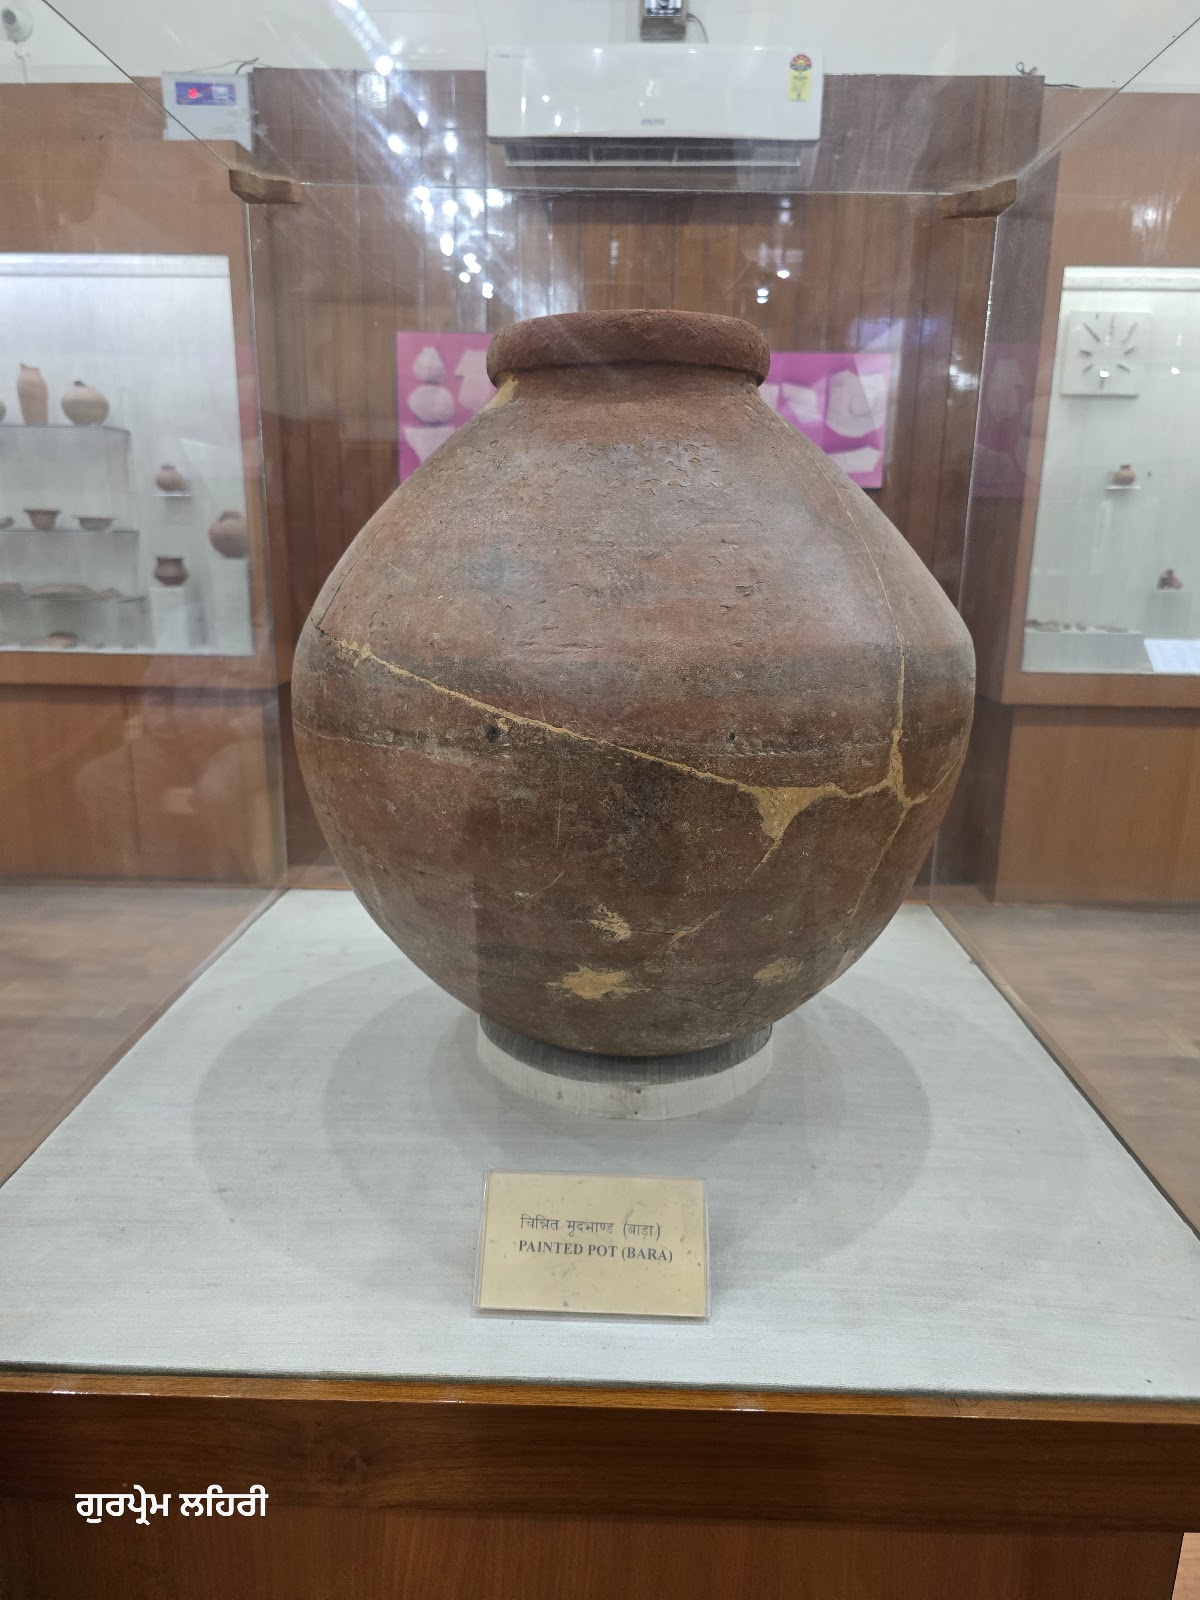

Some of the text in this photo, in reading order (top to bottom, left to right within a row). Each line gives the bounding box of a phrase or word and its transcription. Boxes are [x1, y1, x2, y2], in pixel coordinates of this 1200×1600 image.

[623, 1221, 660, 1241] (बाड़ा)
[519, 1240, 672, 1263] PAINTED POT (BARA)
